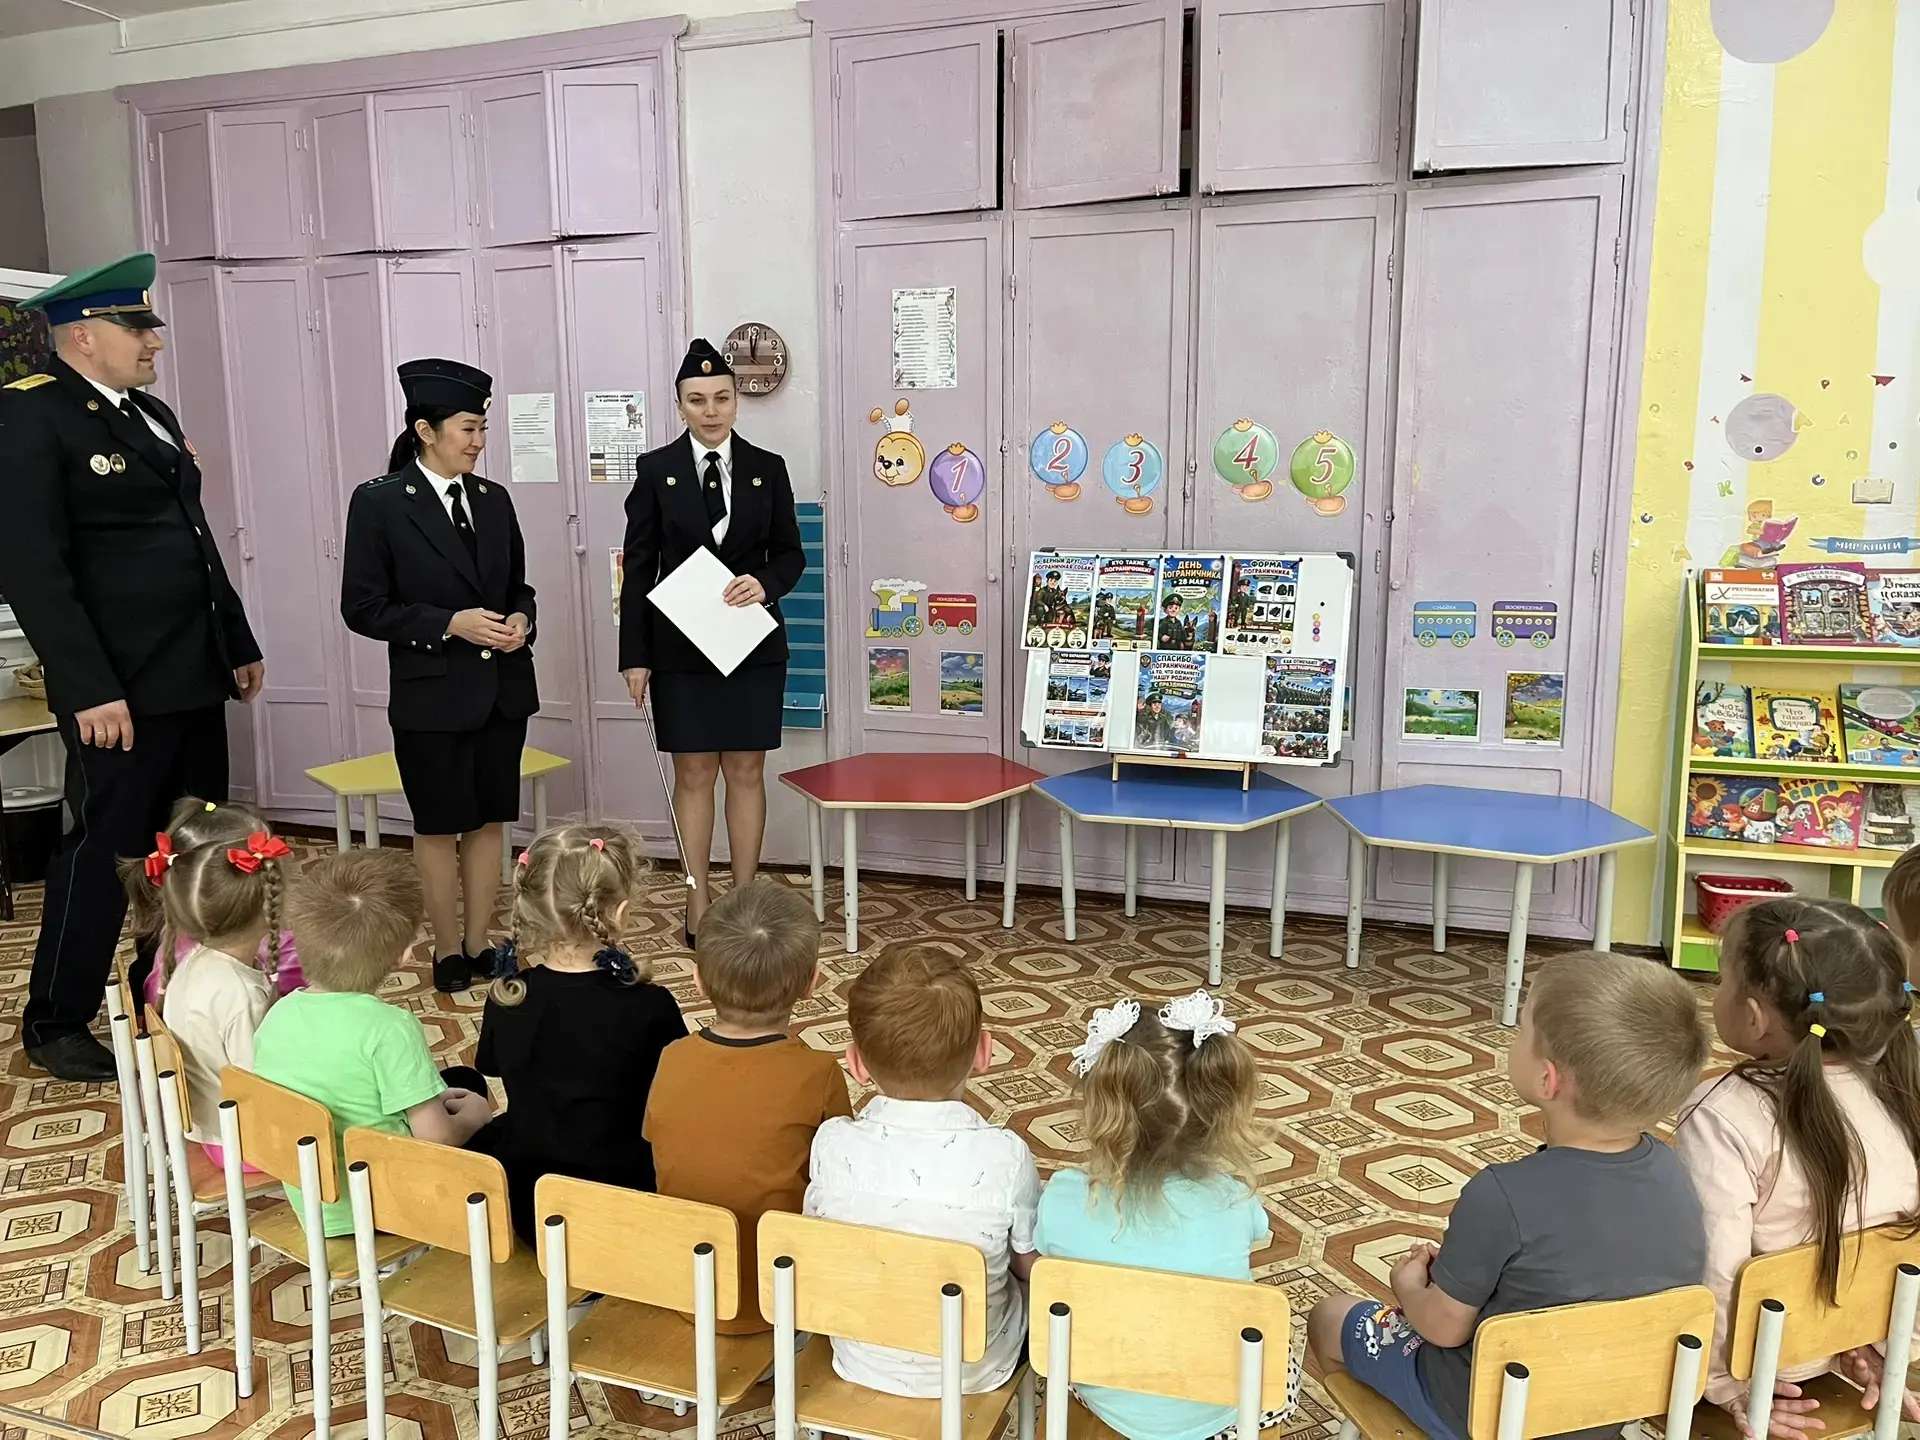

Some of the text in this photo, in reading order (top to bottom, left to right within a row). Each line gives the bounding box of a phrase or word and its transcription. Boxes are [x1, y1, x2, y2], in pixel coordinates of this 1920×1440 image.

[738, 331, 745, 341] 11
[747, 326, 760, 340] 12
[728, 341, 739, 351] 10
[771, 340, 778, 350] 2
[724, 353, 734, 366] 9
[773, 352, 783, 366] 3
[772, 368, 778, 377] 4
[738, 377, 744, 387] 7
[749, 378, 758, 392] 6
[763, 377, 770, 388] 5
[1047, 436, 1072, 472] 2
[1232, 432, 1261, 470] 4
[1122, 450, 1147, 485] 3
[1311, 446, 1338, 485] 5
[950, 457, 965, 493] 1
[1835, 541, 1901, 551] МИР КНИГИ
[1178, 560, 1202, 570] ДЕНЬ
[1250, 560, 1282, 568] ФОРМА
[1163, 570, 1221, 579] ПОГРАНИЧНИКА
[1243, 568, 1290, 576] ПОГРАНИЧНИКА
